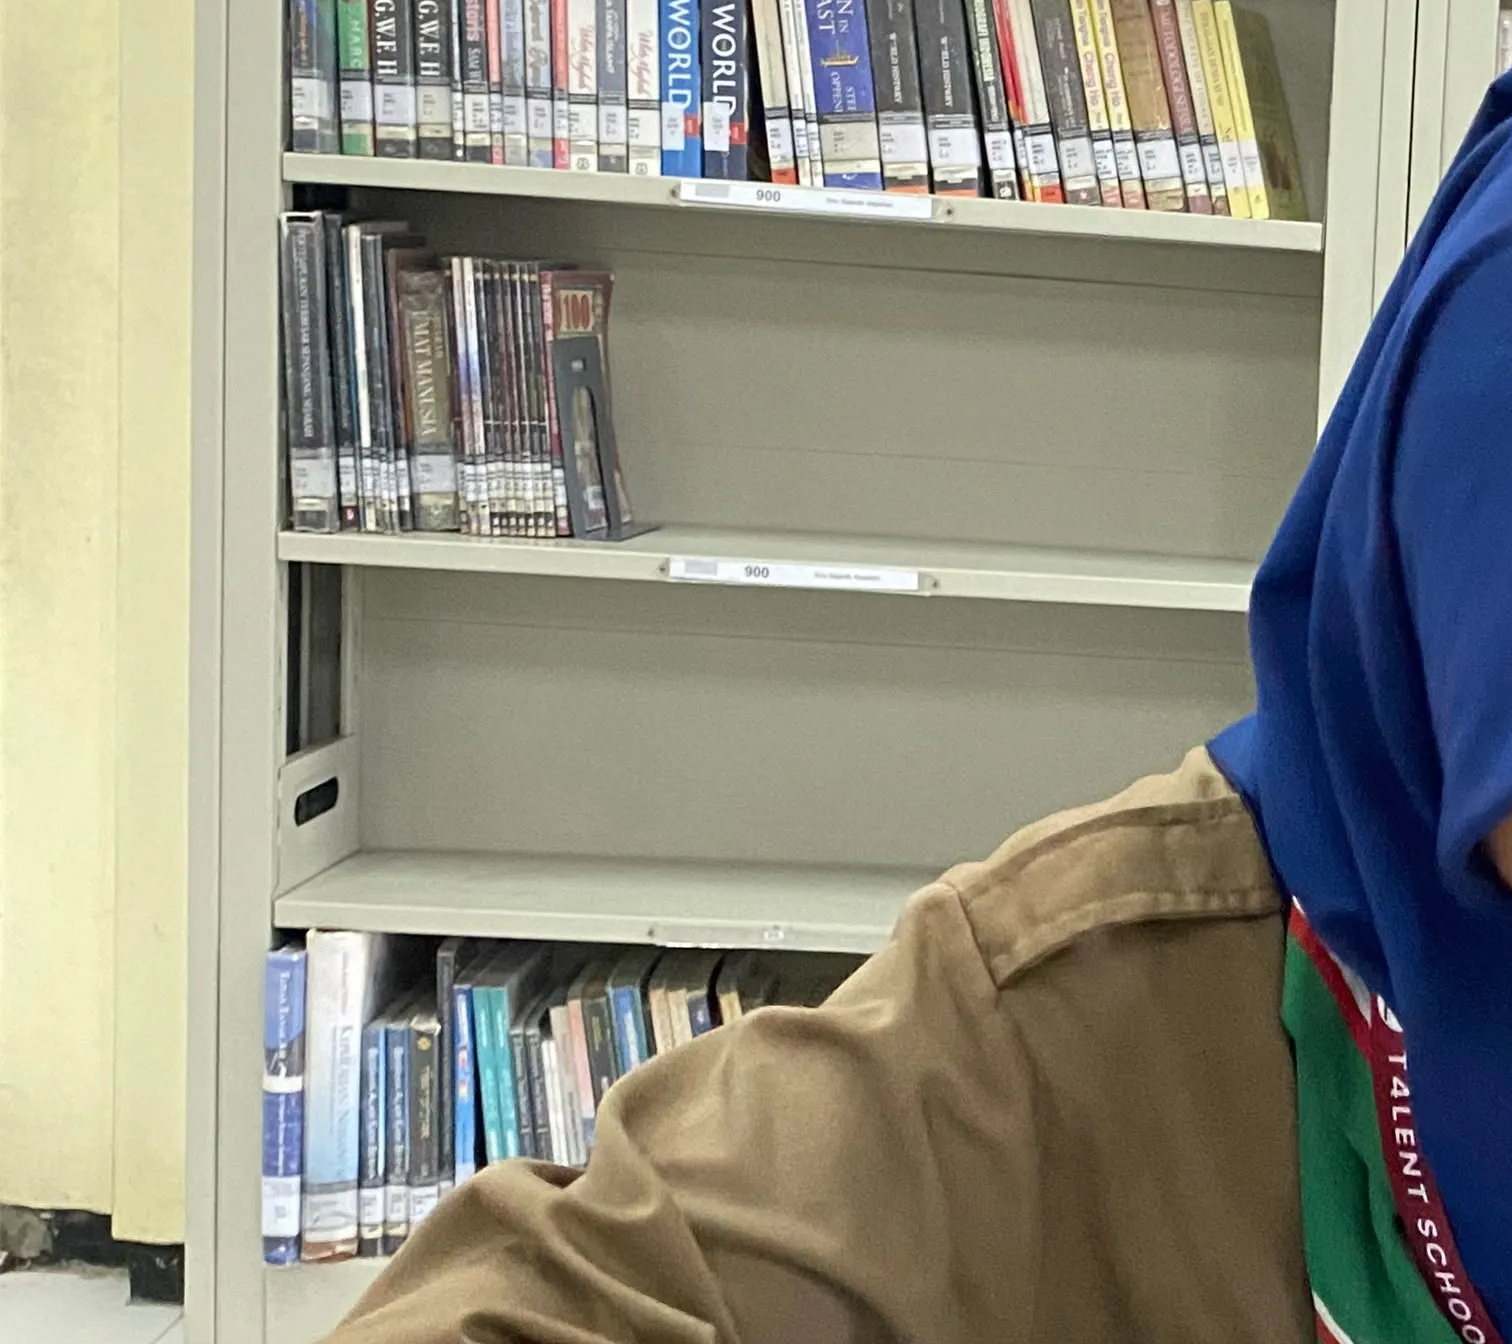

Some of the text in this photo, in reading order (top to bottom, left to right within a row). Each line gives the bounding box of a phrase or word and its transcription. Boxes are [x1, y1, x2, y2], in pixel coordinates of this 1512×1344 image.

[838, 19, 850, 34] IN
[712, 3, 737, 117] WORLD
[755, 189, 782, 203] 900
[559, 292, 594, 332] 100
[744, 565, 770, 579] 900
